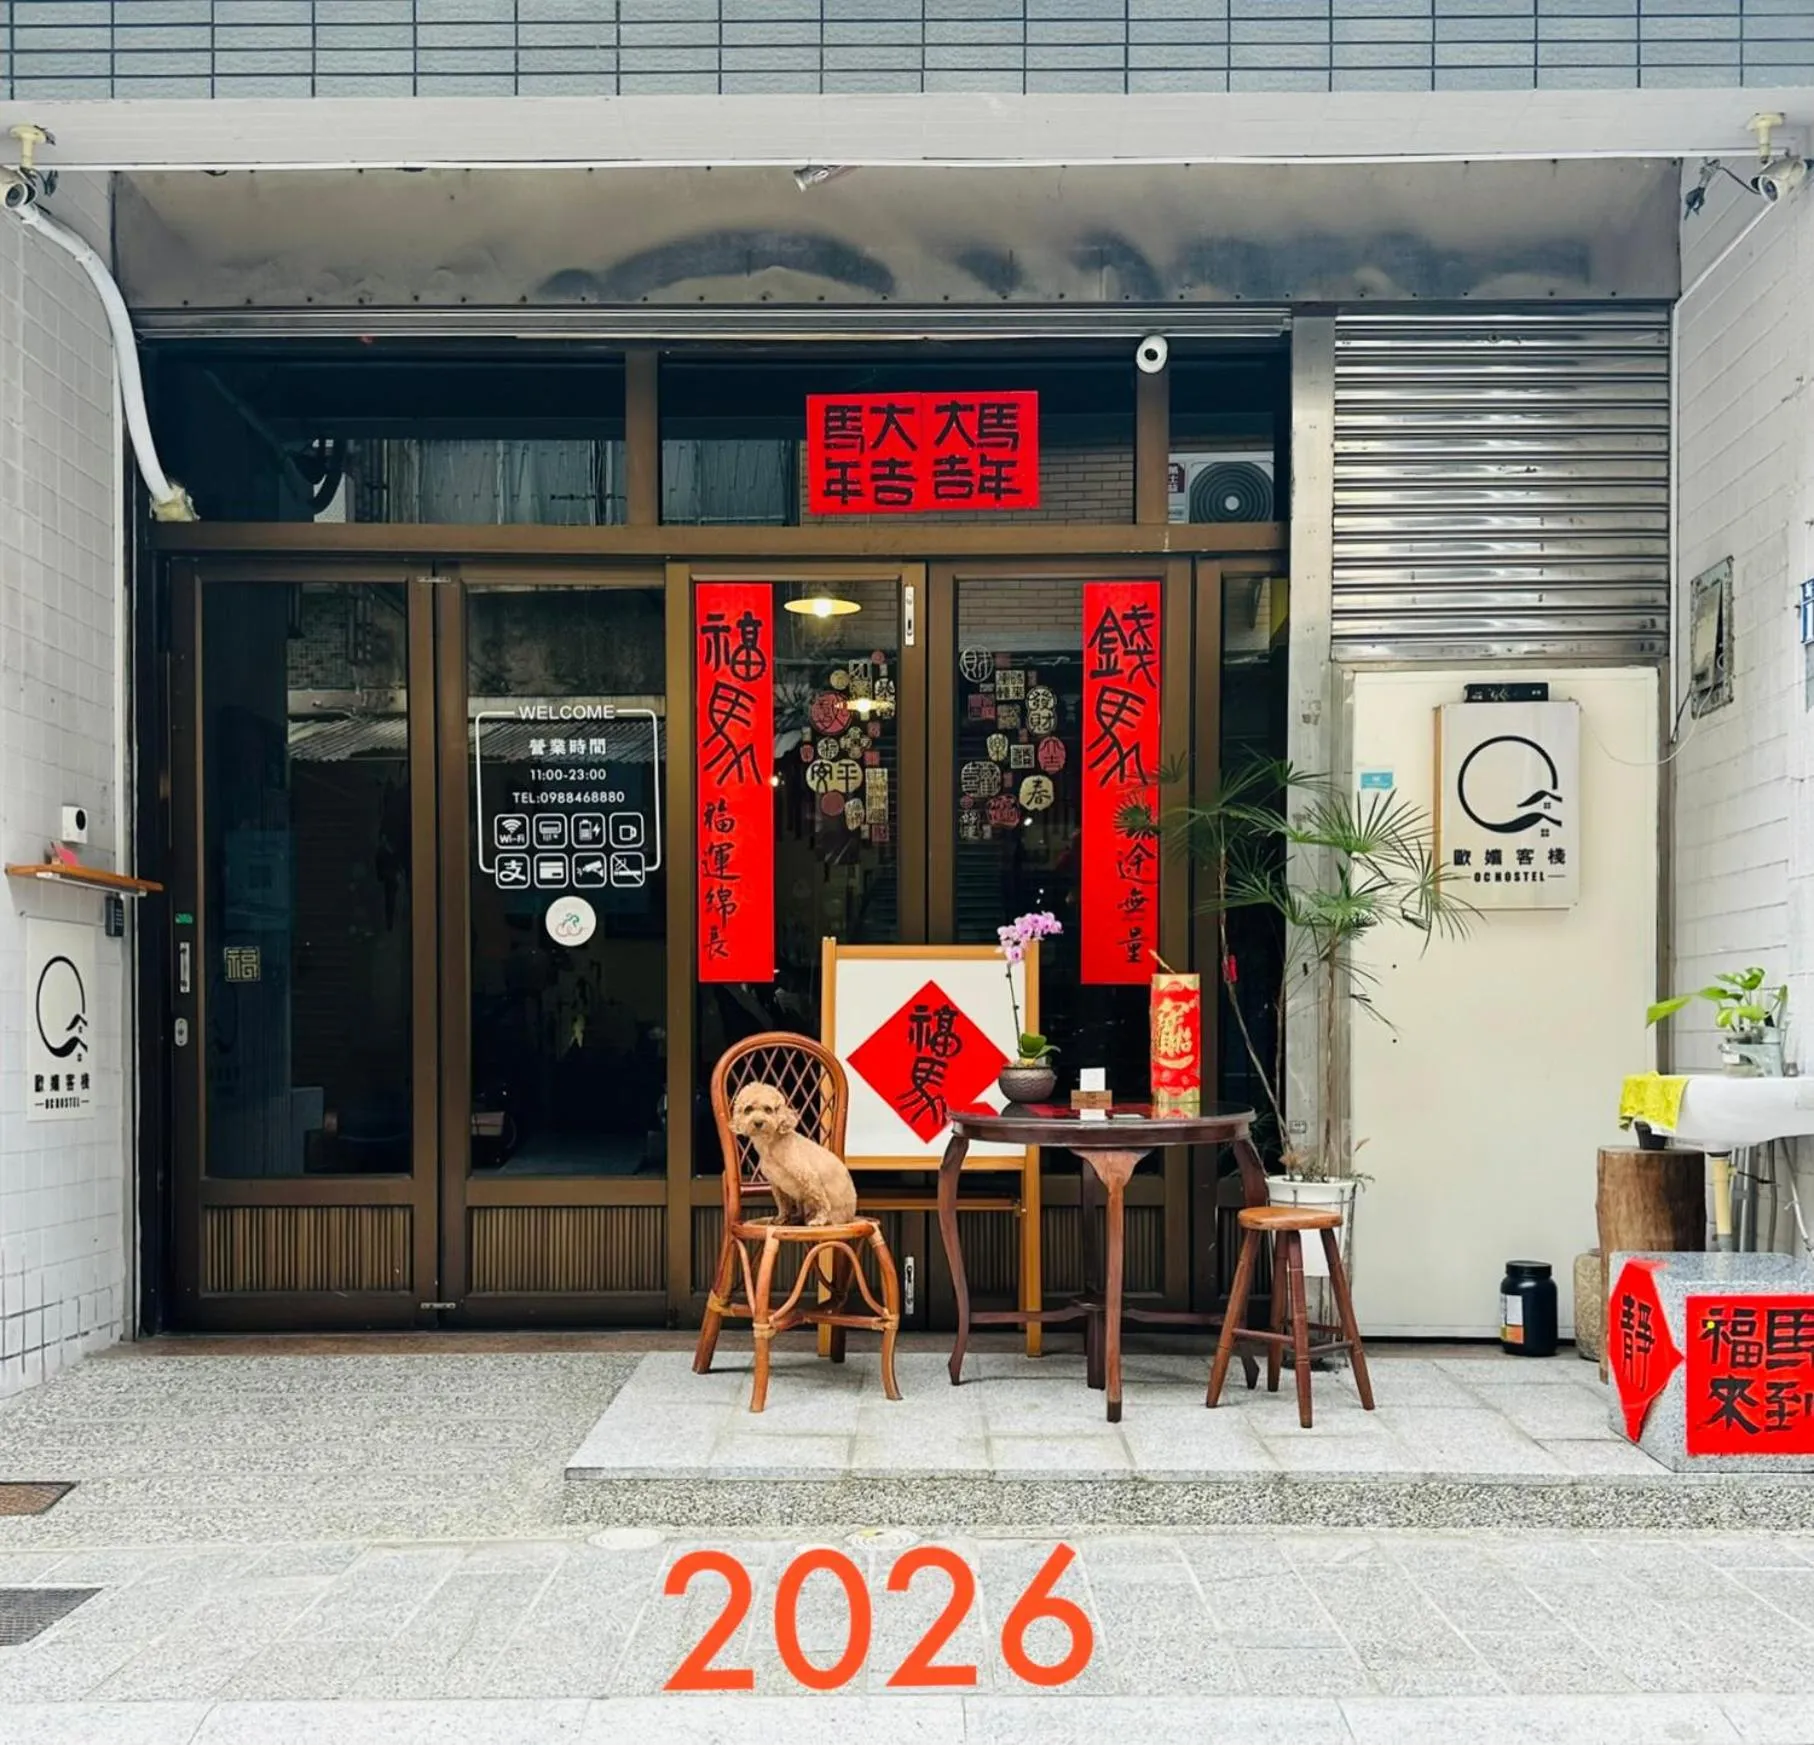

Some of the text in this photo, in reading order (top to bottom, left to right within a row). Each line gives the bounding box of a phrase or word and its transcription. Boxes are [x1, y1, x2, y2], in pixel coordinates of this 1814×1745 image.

[518, 705, 615, 721] WELCOME
[528, 738, 607, 756] 營業時間
[530, 768, 607, 782] 11:00-23:00
[512, 791, 625, 805] TEL:0988468880
[1698, 1307, 1764, 1435] 福來
